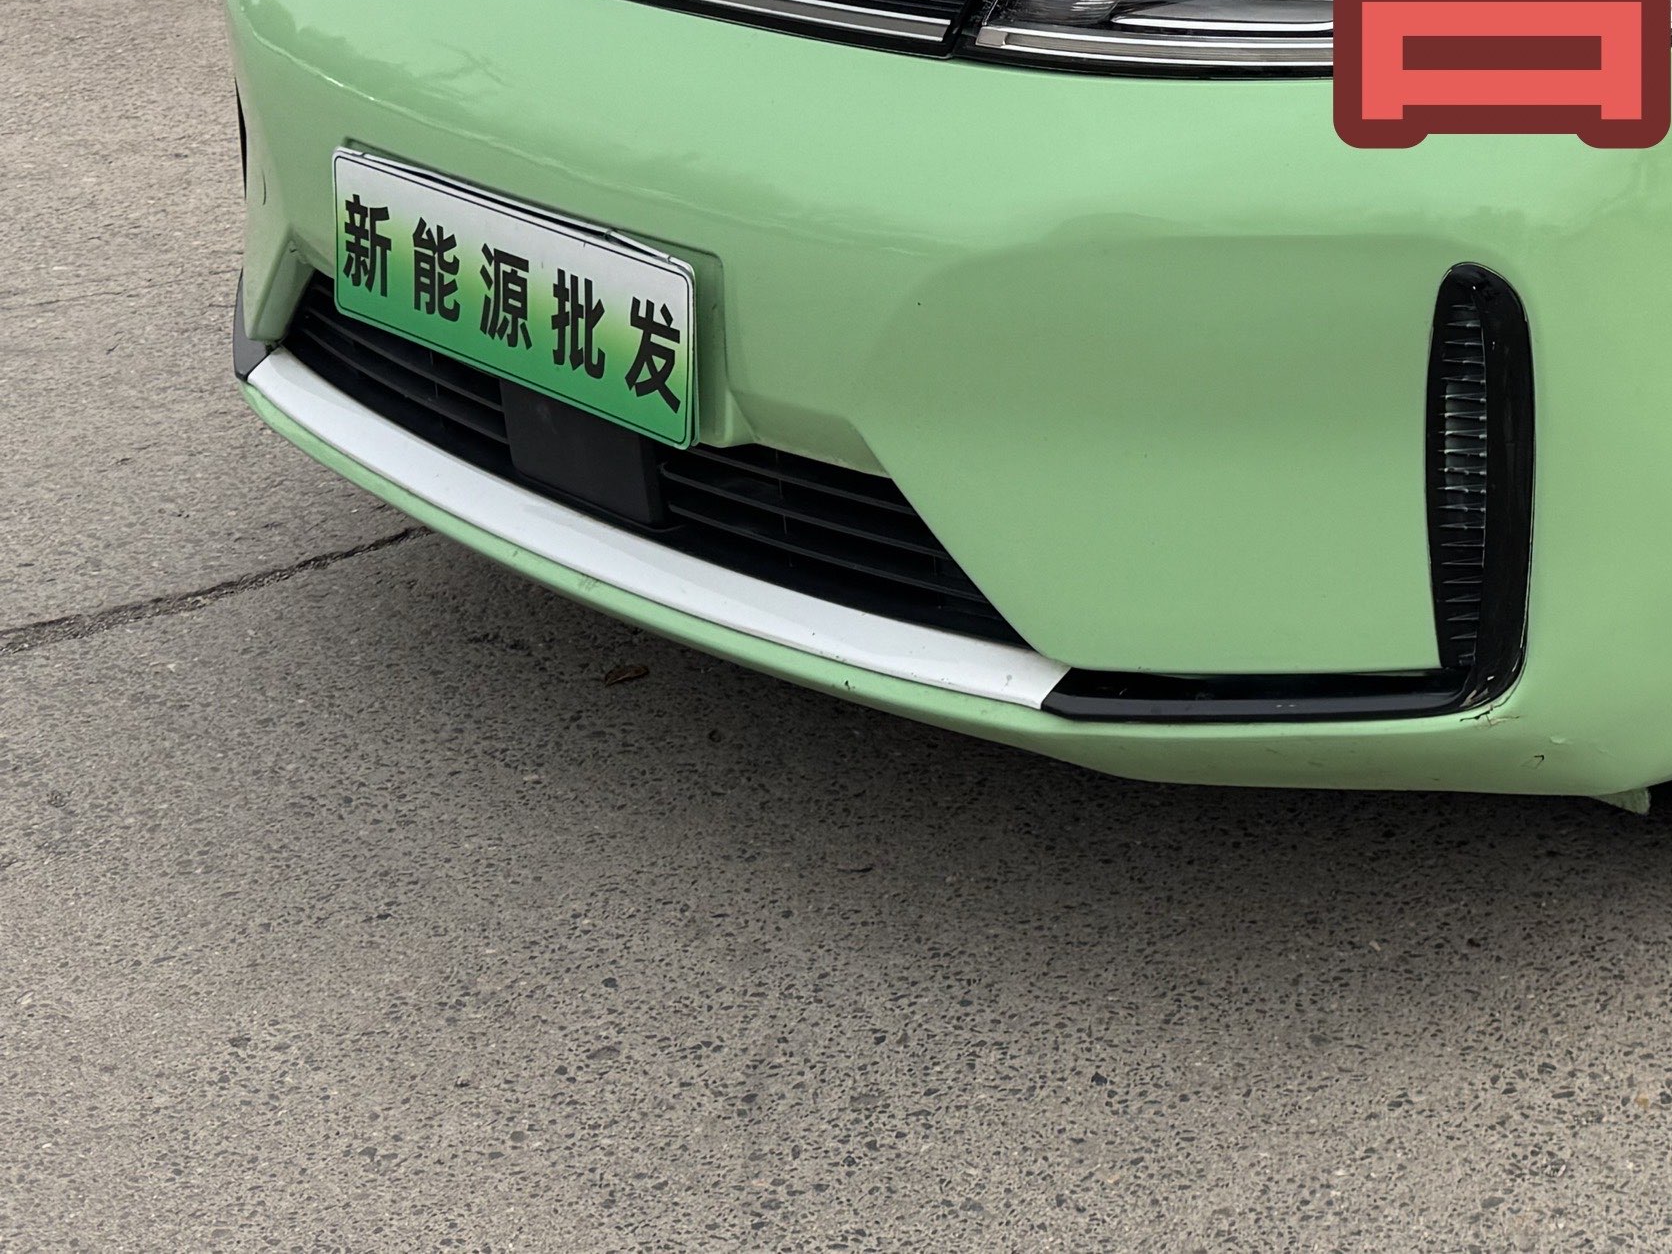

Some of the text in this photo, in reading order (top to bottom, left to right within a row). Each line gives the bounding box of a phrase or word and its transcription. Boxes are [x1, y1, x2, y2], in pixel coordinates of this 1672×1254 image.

[342, 193, 682, 413] 新能源批发
